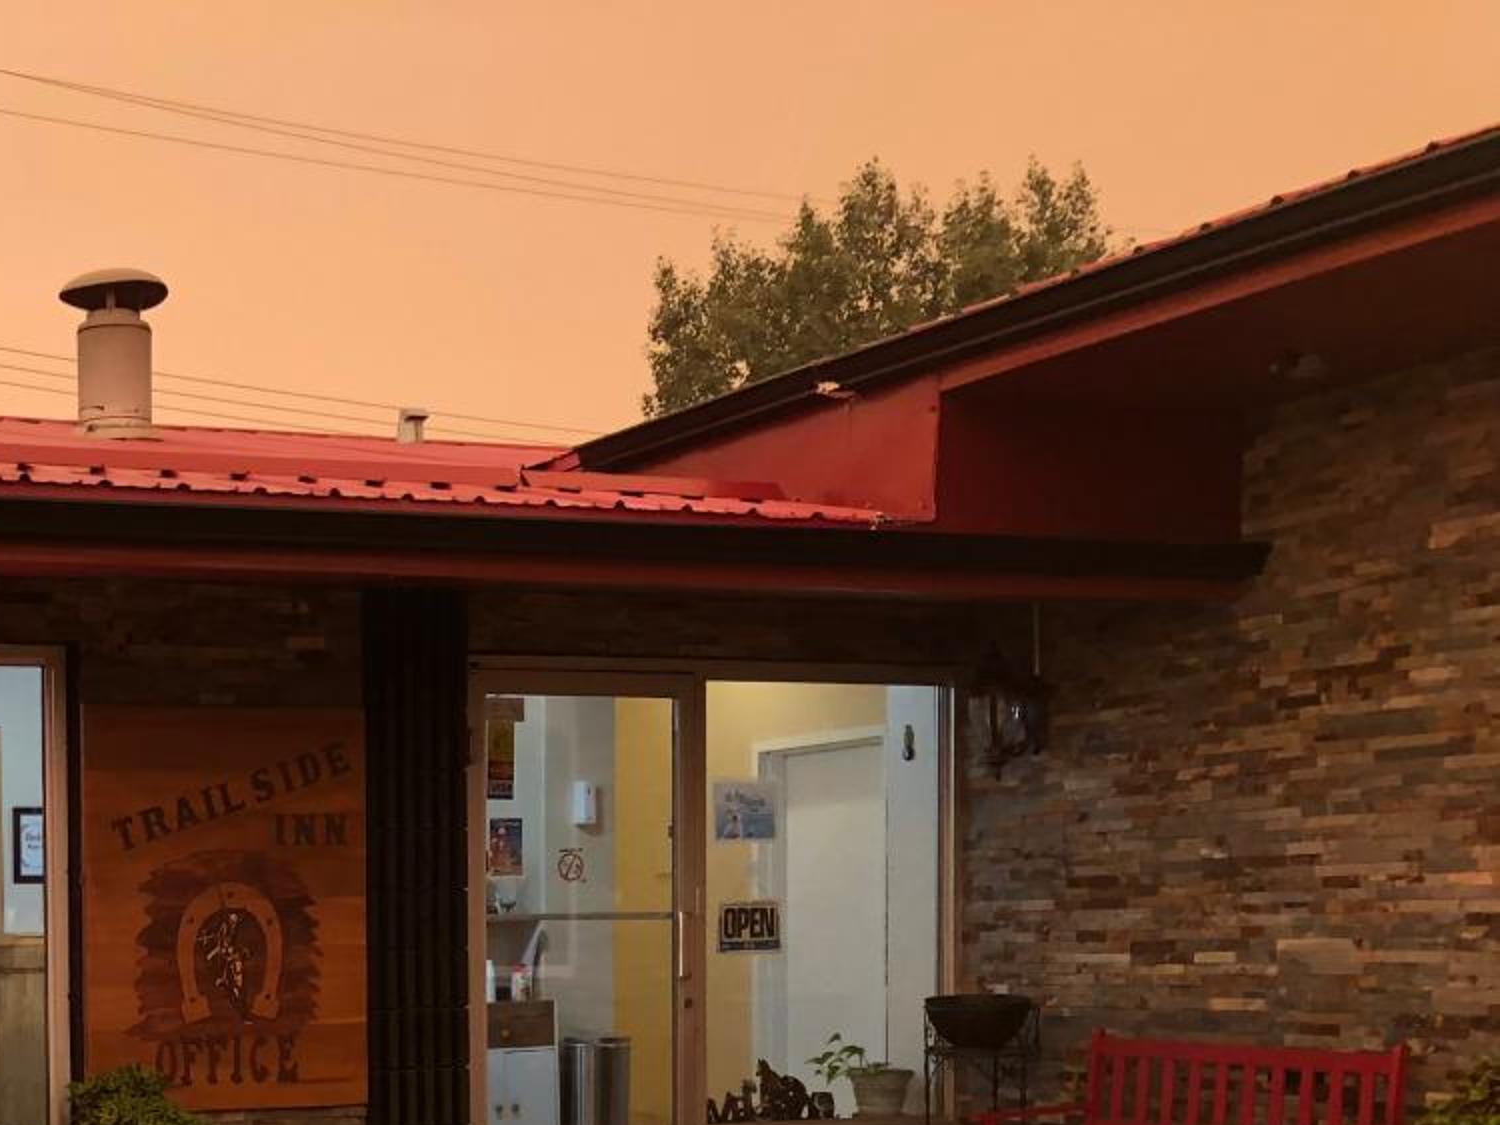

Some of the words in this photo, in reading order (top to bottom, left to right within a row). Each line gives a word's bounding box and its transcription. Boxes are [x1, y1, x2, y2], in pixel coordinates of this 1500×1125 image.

[276, 813, 348, 847] INN
[723, 907, 775, 939] OPEN
[156, 1035, 299, 1087] OFFICE
